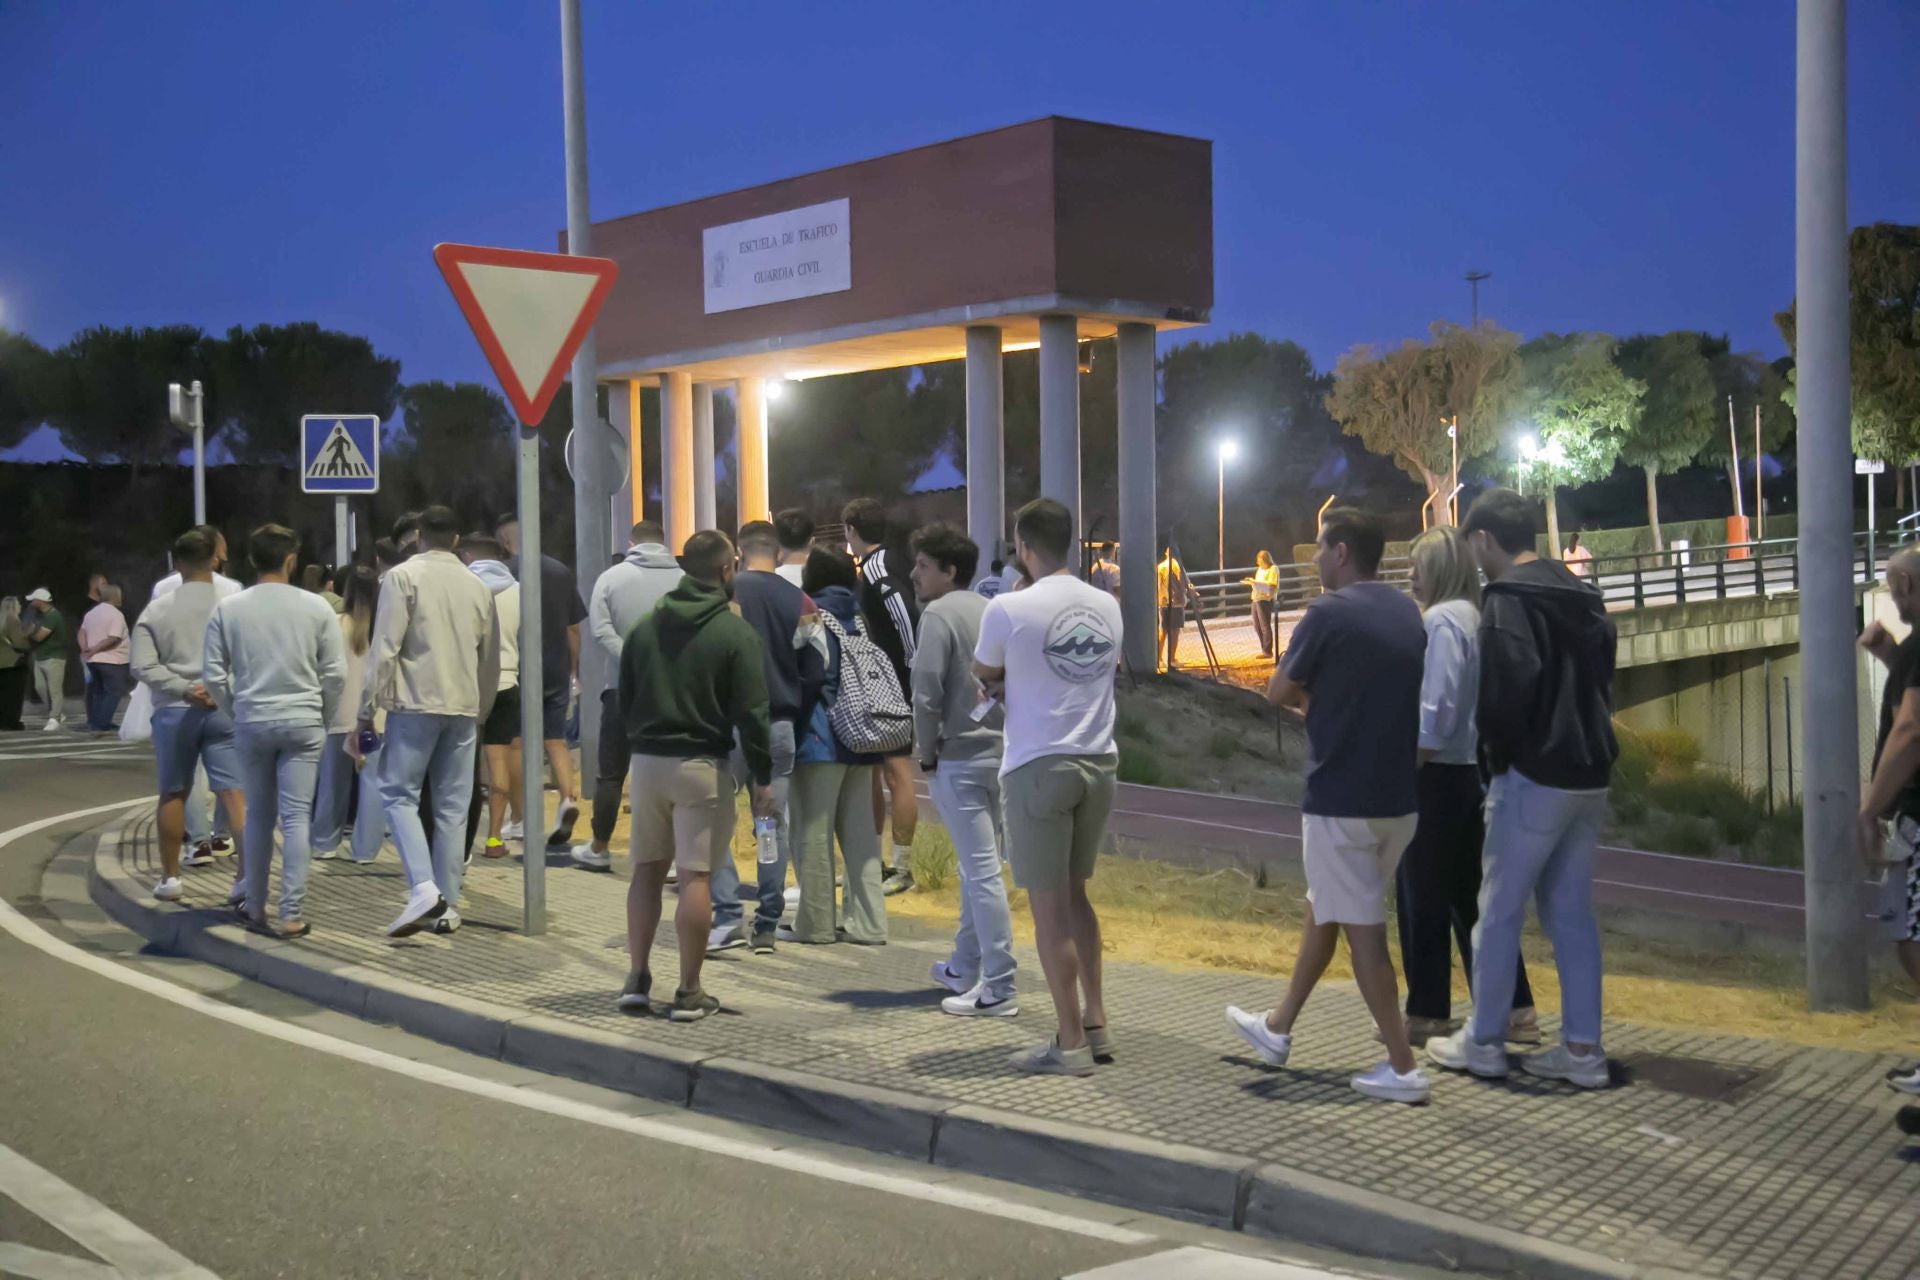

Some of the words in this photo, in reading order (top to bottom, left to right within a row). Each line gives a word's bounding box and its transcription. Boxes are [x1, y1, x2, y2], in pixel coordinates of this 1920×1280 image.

[739, 237, 778, 254] ESCUELA
[782, 232, 794, 245] DE
[754, 265, 794, 284] GUARDIA
[797, 261, 822, 277] CIVIL
